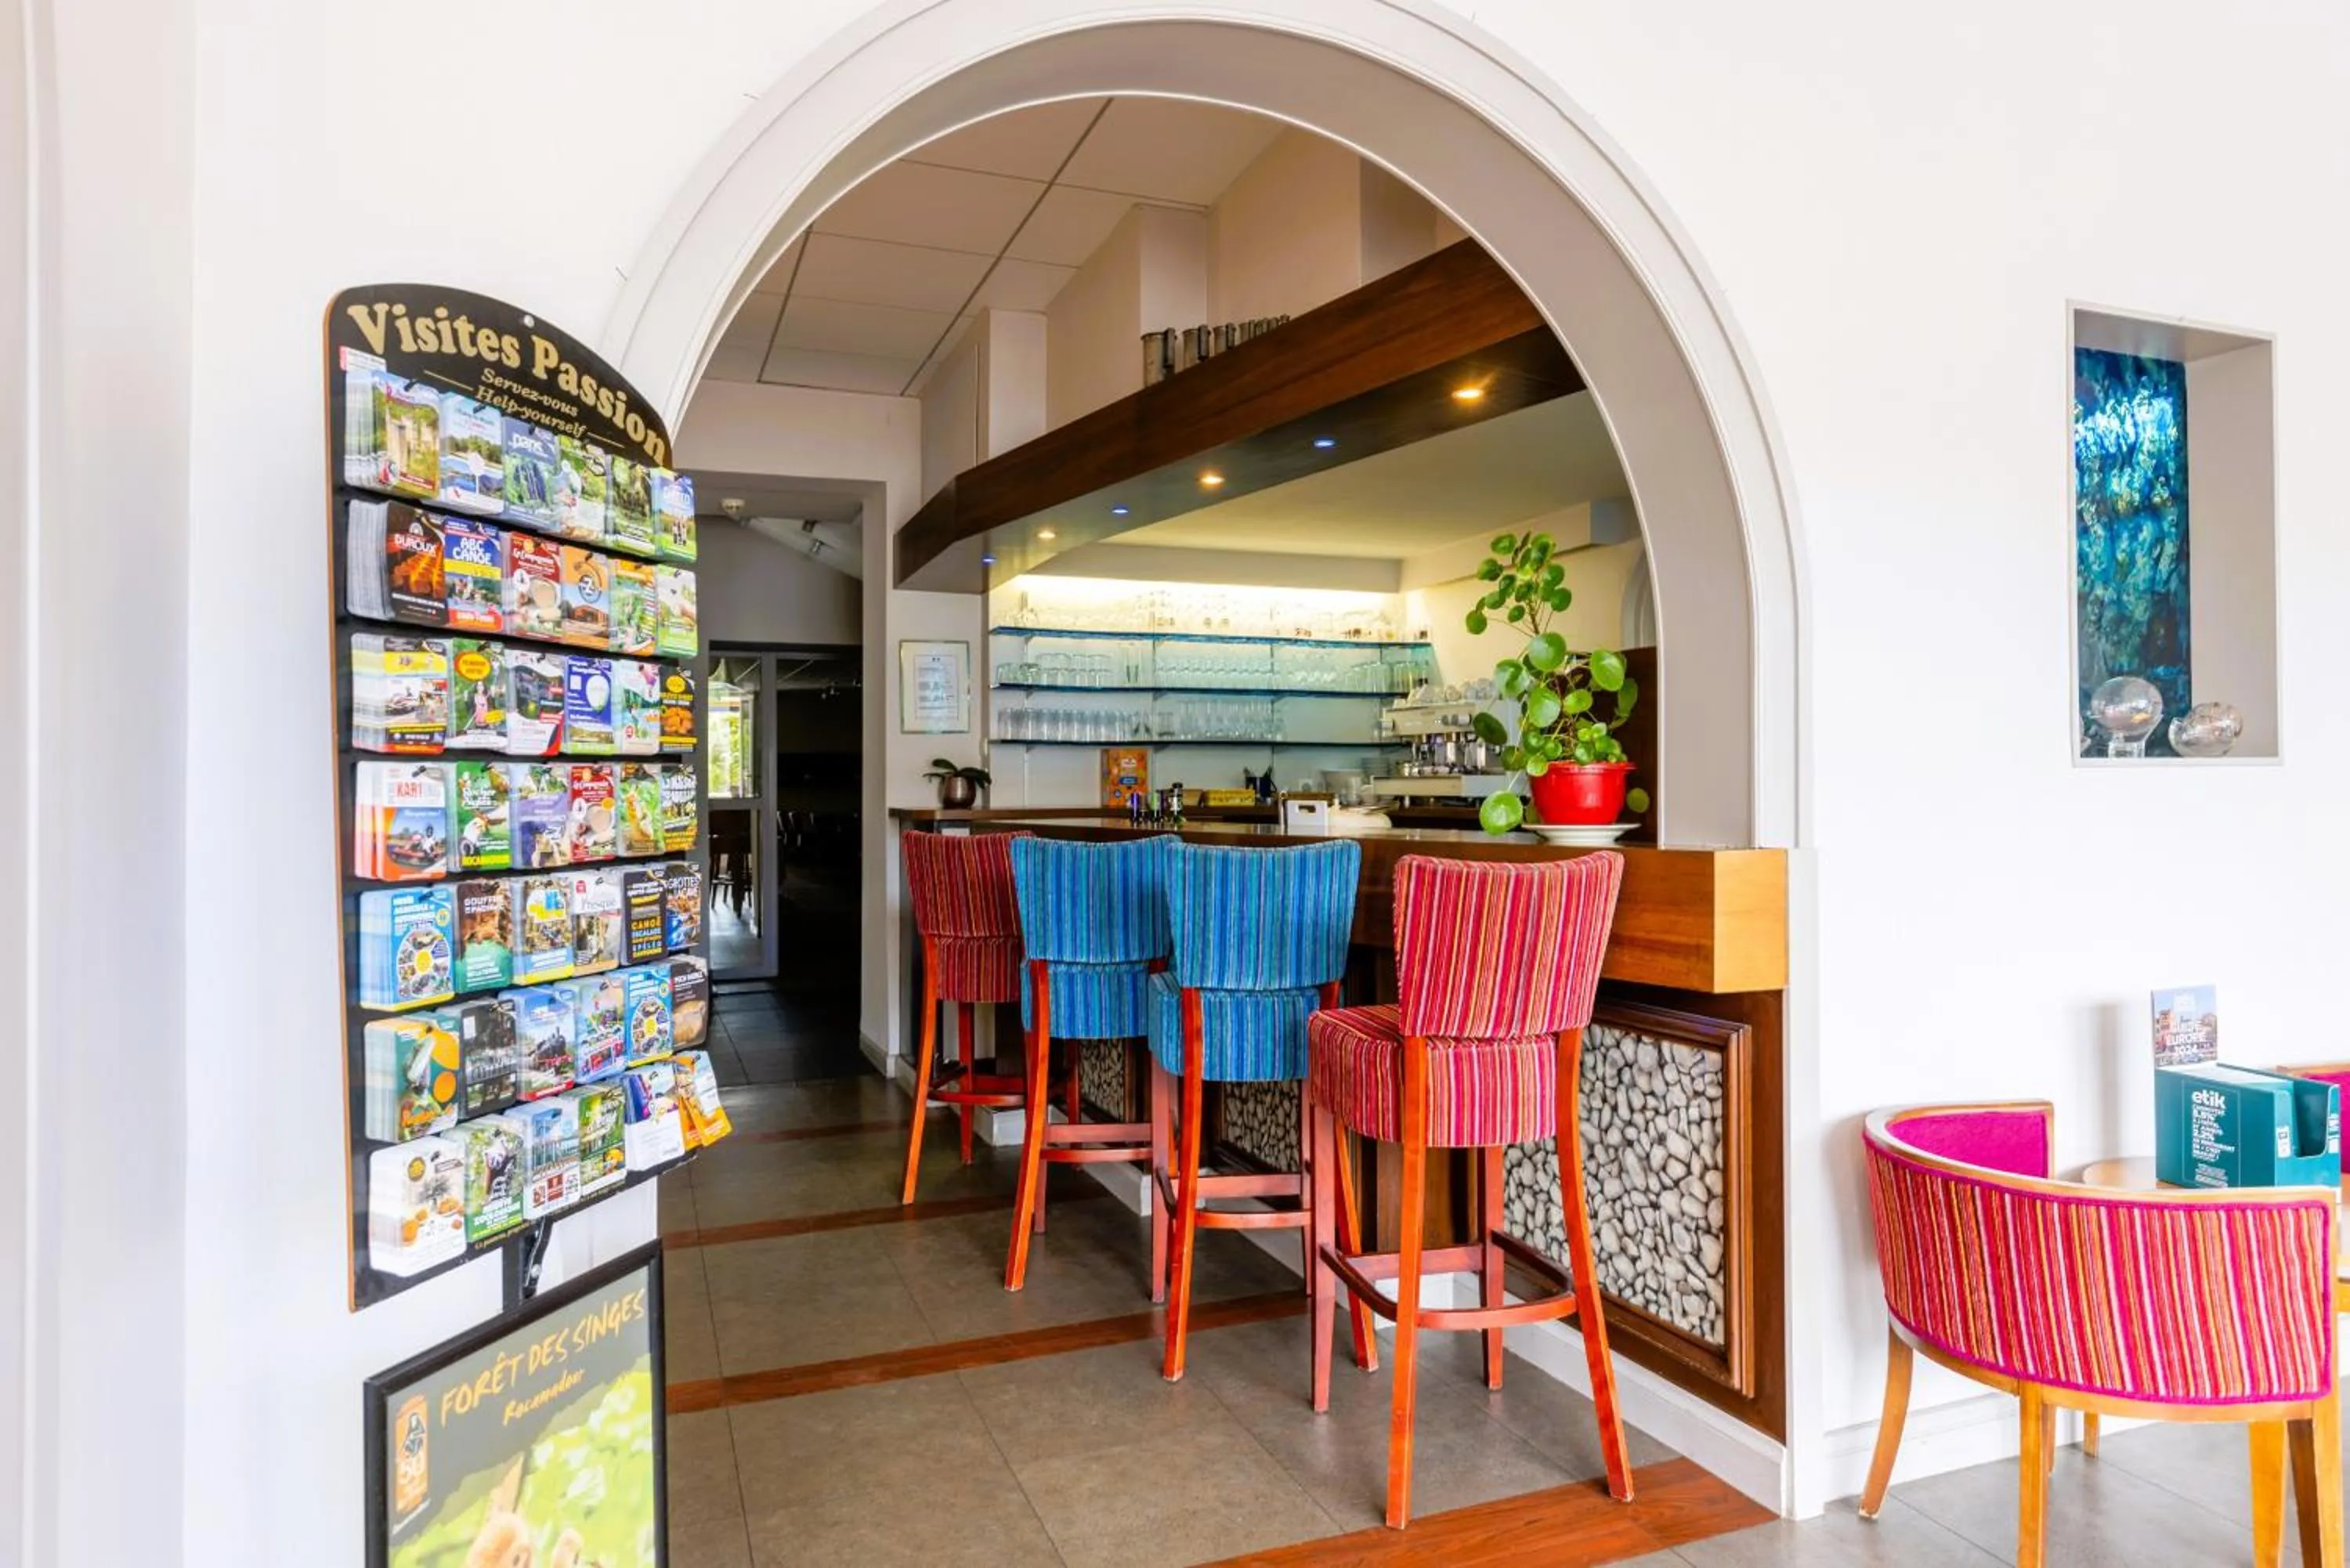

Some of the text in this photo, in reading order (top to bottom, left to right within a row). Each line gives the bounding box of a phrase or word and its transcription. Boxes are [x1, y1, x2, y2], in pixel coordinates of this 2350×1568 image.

[347, 302, 670, 467] Visites Passion
[480, 367, 578, 417] Servez-vous
[475, 385, 588, 439] Help-yourself
[460, 537, 485, 552] ABC
[2192, 1089, 2227, 1110] etik
[439, 1287, 647, 1429] FORÊT DES SINGES
[501, 1367, 587, 1428] Rocamadour
